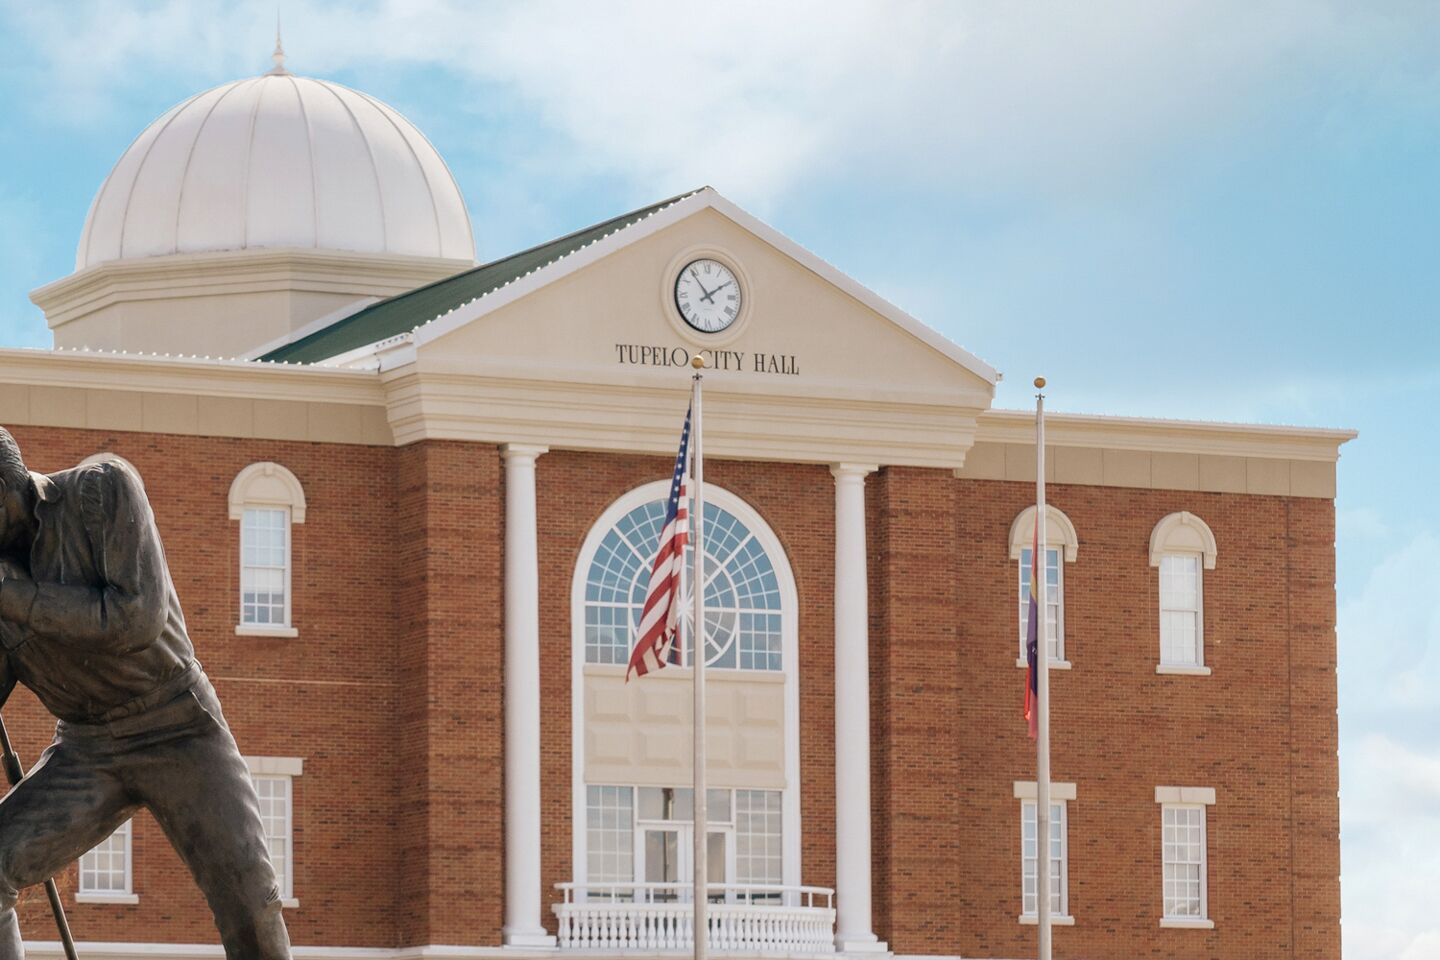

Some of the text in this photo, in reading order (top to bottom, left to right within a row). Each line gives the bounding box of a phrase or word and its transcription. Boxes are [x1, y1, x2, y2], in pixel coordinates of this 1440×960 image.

[615, 344, 800, 376] TUPELO CITY HALL
